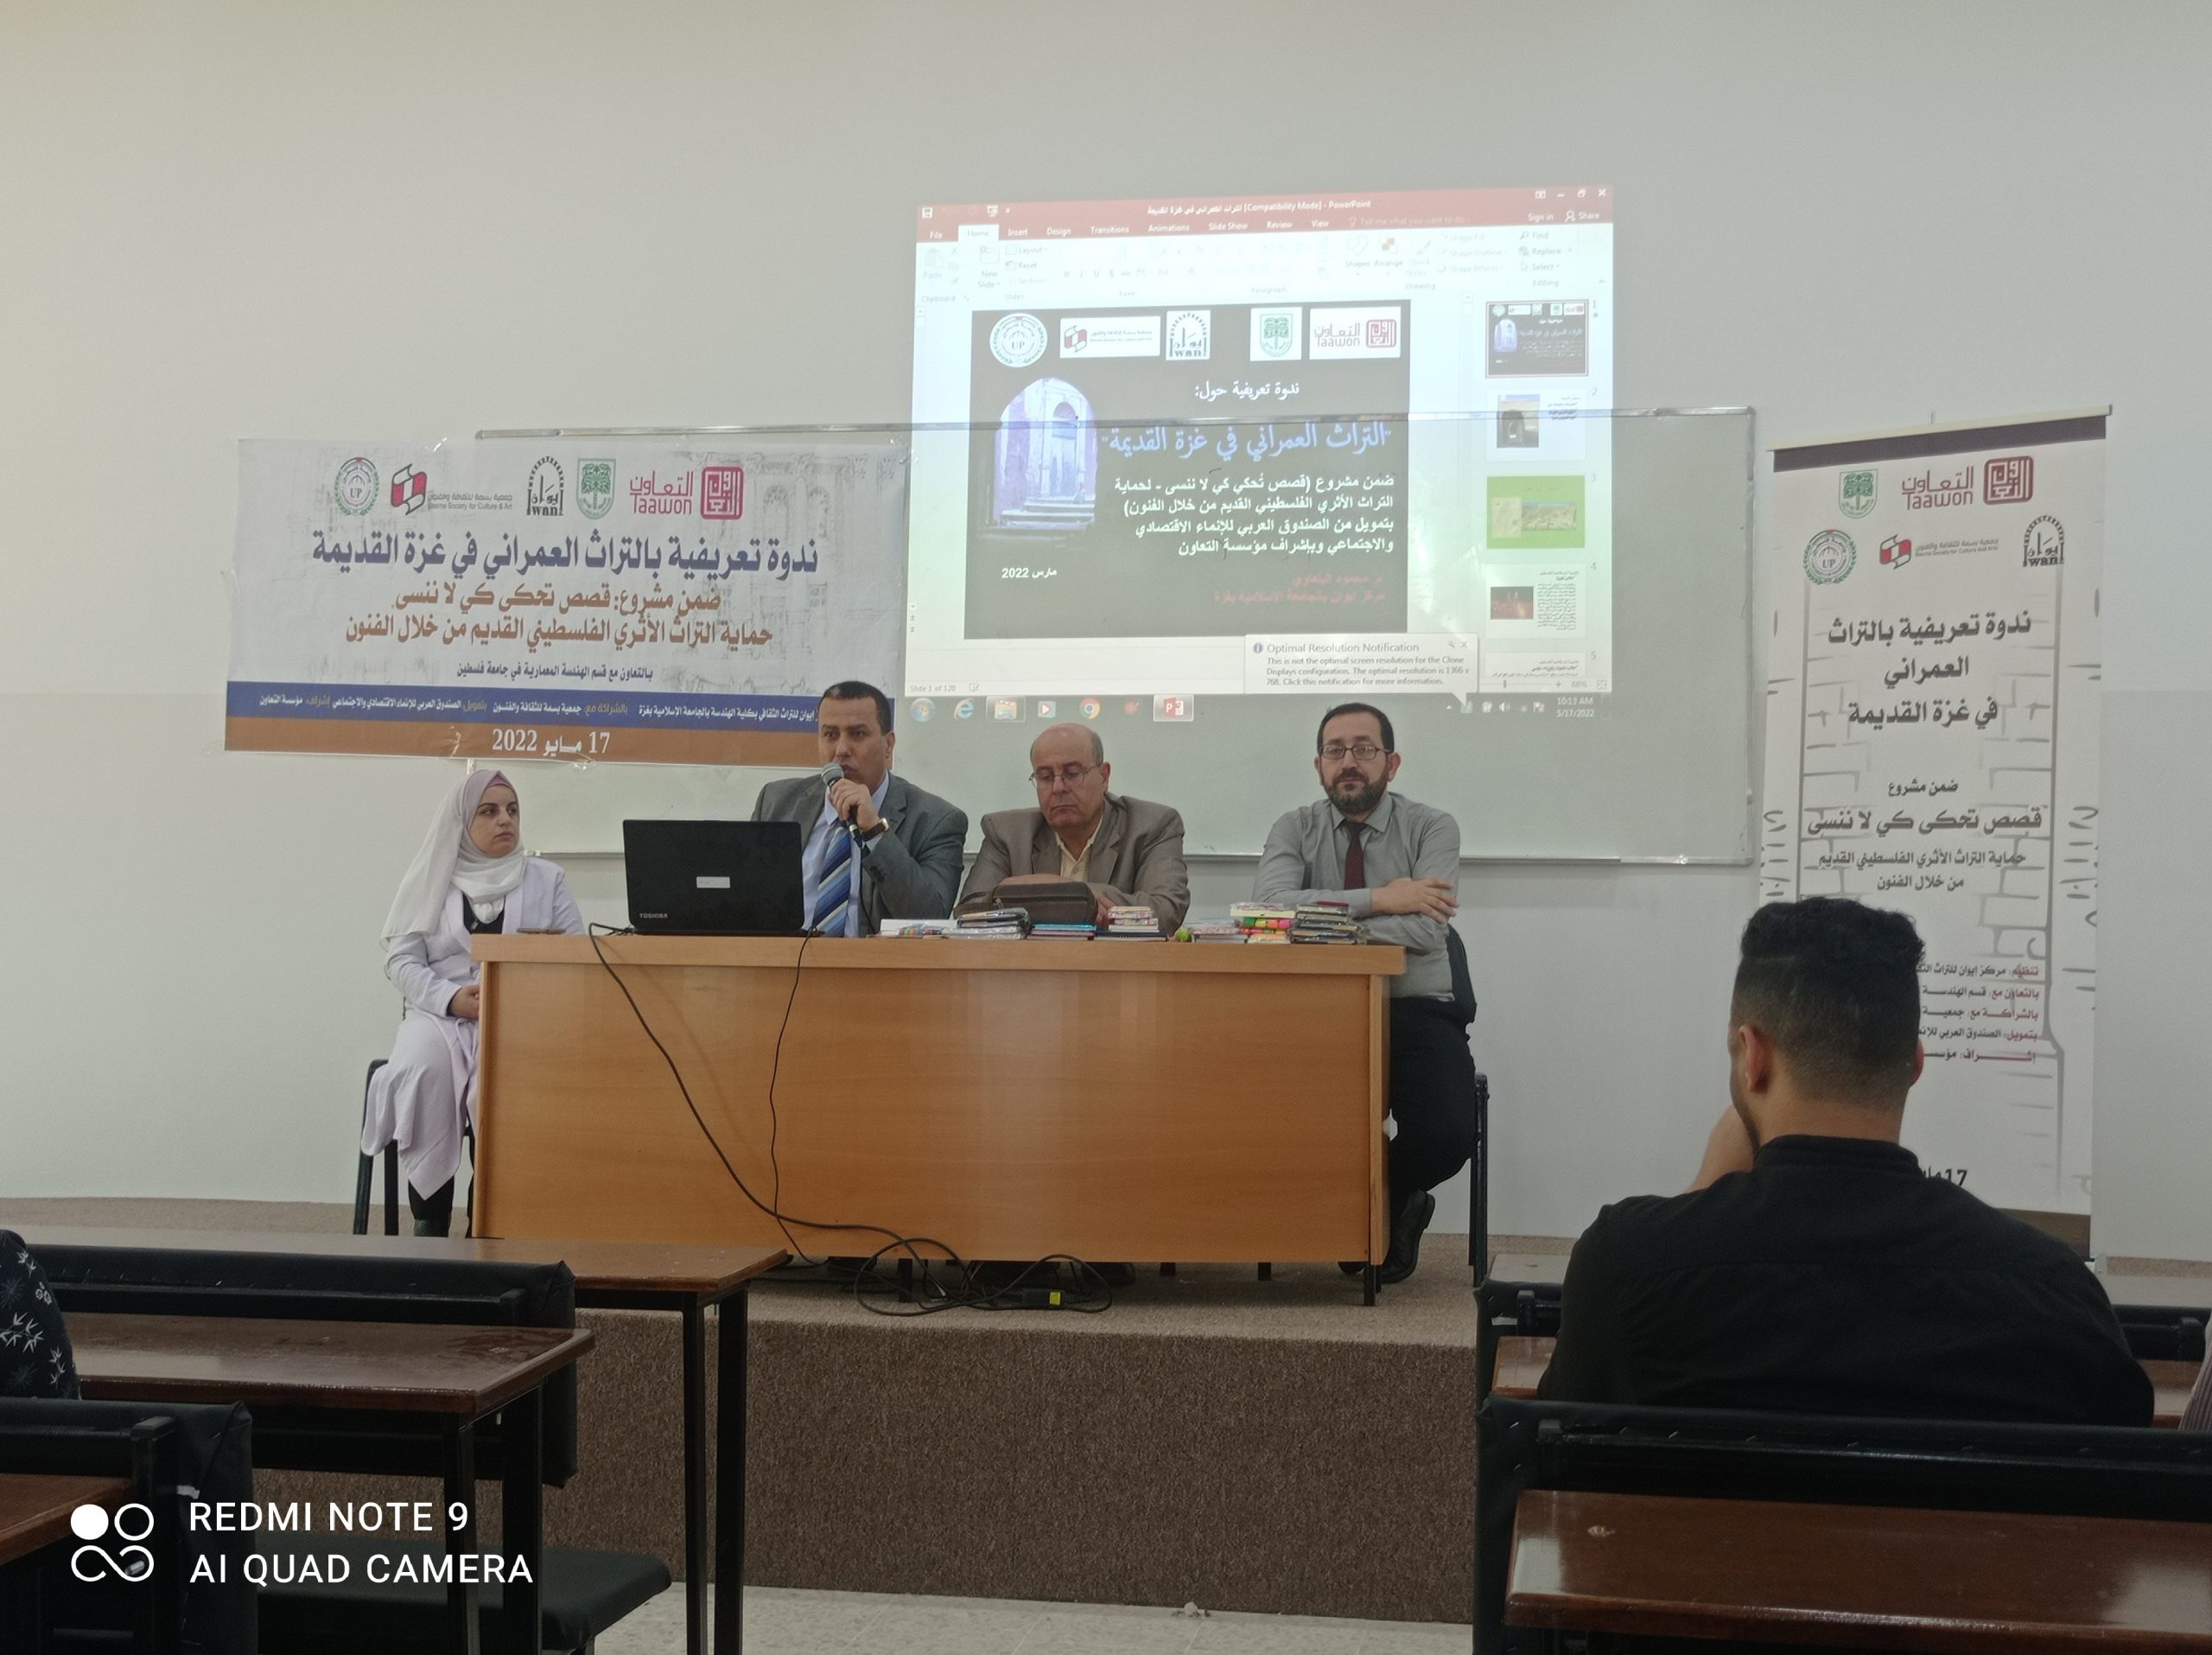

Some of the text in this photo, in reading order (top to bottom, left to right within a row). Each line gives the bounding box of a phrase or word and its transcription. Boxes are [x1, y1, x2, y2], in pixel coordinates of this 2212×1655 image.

[1328, 200, 1371, 209] PowerPoint
[930, 231, 943, 239] File
[1007, 227, 1028, 236] Insert
[1046, 227, 1071, 237] Design
[1090, 226, 1129, 234] Transitions
[1147, 224, 1190, 232] Animations
[1208, 222, 1225, 231] Slide
[1267, 220, 1293, 229] Review
[1311, 220, 1329, 228] View
[1528, 213, 1542, 223] Sign
[1578, 212, 1600, 220] Share
[1531, 231, 1549, 239] Find
[1531, 247, 1561, 257] Replace
[1531, 263, 1554, 271] Select
[1195, 380, 1300, 402] ندوة تعريفية حول:
[1174, 421, 1318, 462] العمراني في غزة
[629, 470, 694, 498] التعاون
[1114, 474, 1395, 495] ضمن مشروع كي لا ننسى لحماية
[1901, 465, 1974, 493] التعاون
[349, 487, 362, 499] UP
[1357, 494, 1394, 510] التراث
[1902, 490, 1974, 511] Taawon
[630, 493, 692, 515] Taawon
[1168, 499, 1196, 514] خلال
[1198, 500, 1216, 514] من
[1219, 498, 1251, 514] القديم
[1255, 496, 1313, 514] الفلسطيني
[1135, 519, 1395, 539] بتمويل من الصندوق العربي الاقتصادي
[312, 528, 819, 581] ندوة تعريفية بالتراث العمراني في غزة القديمة
[1178, 538, 1395, 557] والاجتماعي مؤسسة التعاون
[1821, 558, 1837, 569] UP
[1001, 567, 1058, 580] مارس 2022
[395, 580, 439, 610] ننسى
[442, 581, 457, 604] لا
[460, 582, 496, 614] كي
[558, 582, 611, 614] قصص
[613, 582, 674, 618] مشروع:
[677, 586, 721, 617] ضمن
[346, 612, 774, 653] حماية التراث الأثري الفلسطيني القديم من خلال الفنون
[1827, 609, 2031, 647] ندوة تعريفية بالتراث
[1267, 642, 1420, 654] Optimal Resolution Notification
[1319, 657, 1349, 665] optimal
[457, 661, 653, 683] بالتعاون مع قسم الهندسة المعمارية في جامعة فلسطين
[1266, 667, 1297, 677] Displays
[1298, 667, 1351, 677] configuration.
[1368, 667, 1397, 676] optimal
[1883, 654, 1970, 690] العمراني
[1556, 697, 1594, 706] 10:13 AM
[712, 706, 736, 719] الهندسة
[737, 707, 759, 720] بكلية
[780, 708, 799, 721] للتراث
[1556, 709, 1595, 718] 5/17/2022
[1848, 696, 1998, 730] في غزة القديمة
[492, 728, 611, 757] 17 مايو 2022
[1887, 778, 1959, 797] ضمن مشروع
[1807, 806, 2042, 837] قصص كي لا ننسى
[1818, 848, 2027, 870] حماية التراث الفلسطيني القديم
[1876, 875, 1964, 892] من خلال الفنون
[1979, 964, 2006, 978] مركز
[2005, 987, 2039, 1000] بالتعاون
